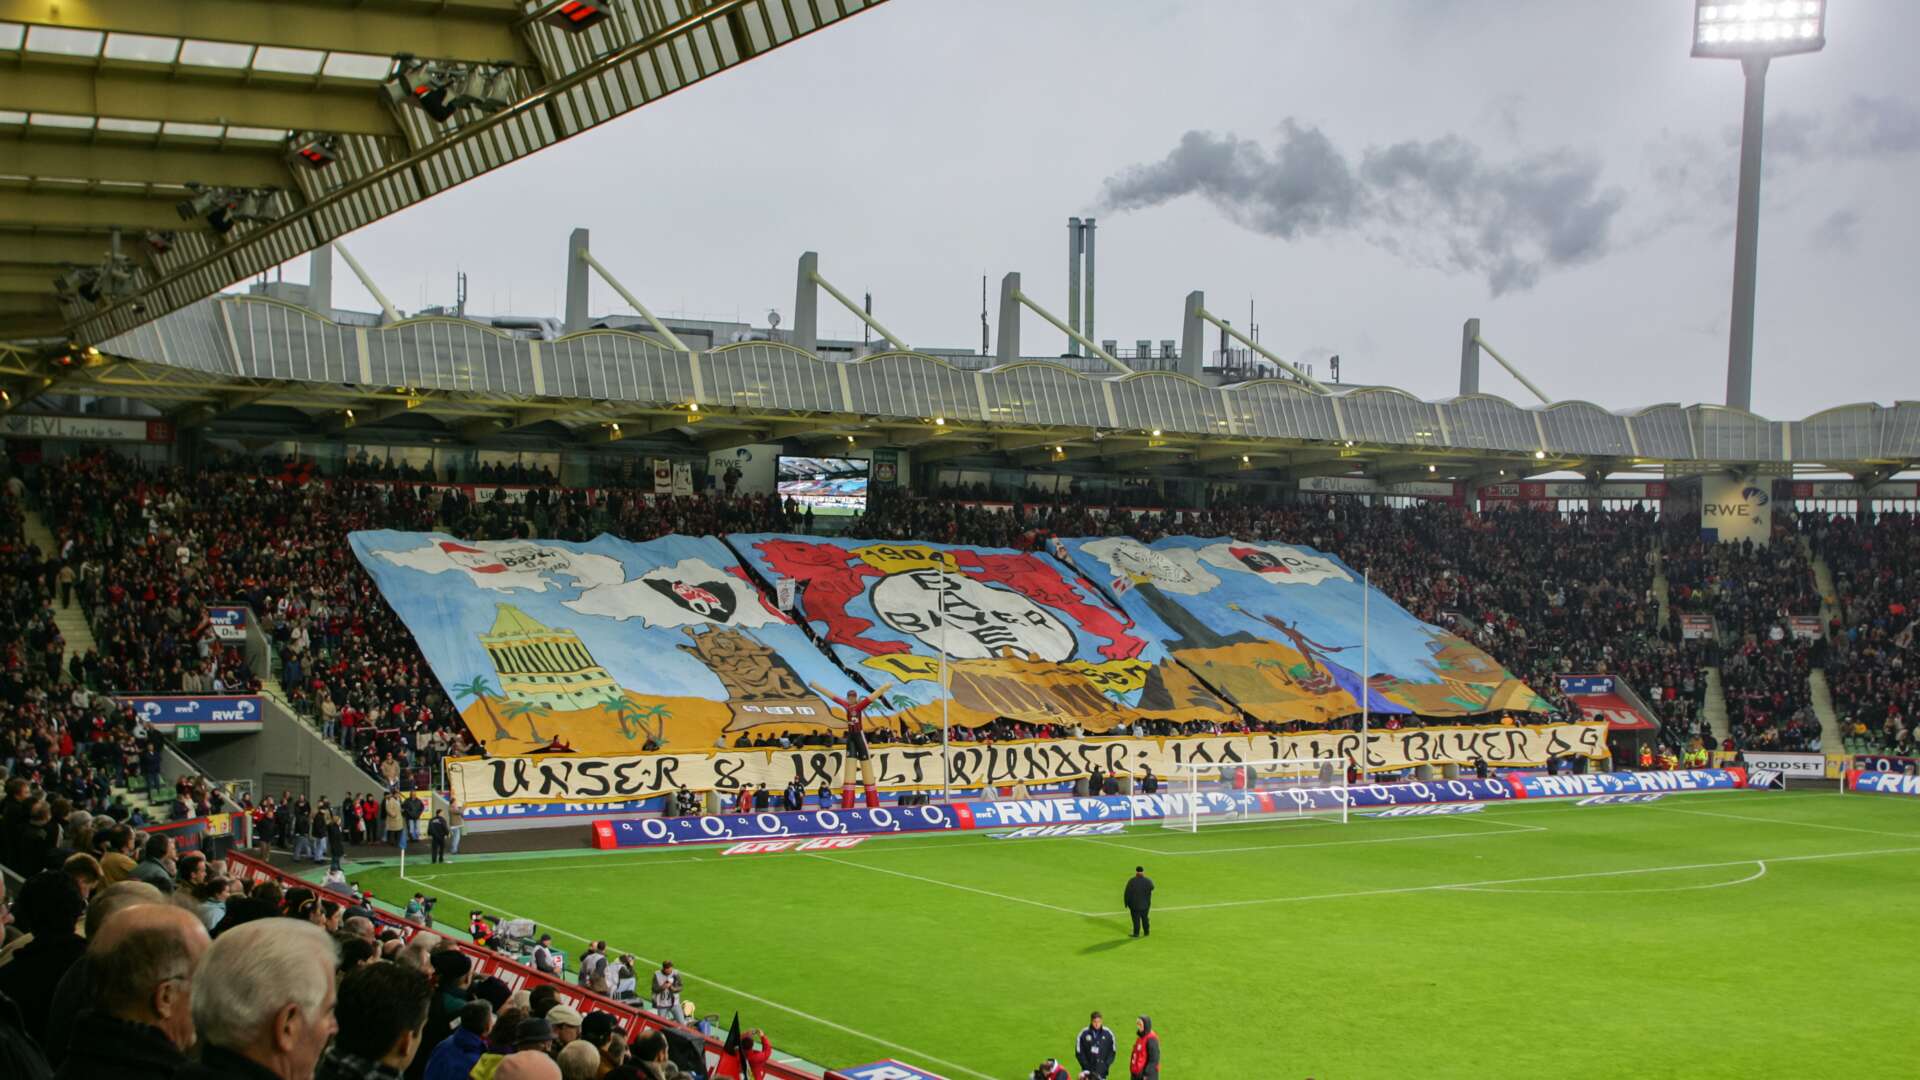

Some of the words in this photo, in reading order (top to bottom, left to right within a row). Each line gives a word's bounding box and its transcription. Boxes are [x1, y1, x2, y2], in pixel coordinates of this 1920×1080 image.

[1704, 504, 1749, 516] RWE
[212, 710, 245, 720] RWE
[489, 755, 682, 798] UNSER
[791, 743, 1152, 787] WLTWUNDER:
[1401, 730, 1533, 762] BAYER
[1755, 761, 1822, 771] ODDSET
[1448, 780, 1474, 800] O2
[1485, 778, 1510, 798] O2
[1535, 774, 1604, 795] RWE
[1632, 770, 1697, 791] RWE
[994, 799, 1082, 824] RWE
[1127, 793, 1210, 817] RWE
[642, 819, 678, 843] O2
[700, 816, 733, 840] O2
[757, 813, 788, 837] O2
[816, 810, 848, 834] O2
[869, 808, 901, 831] O2
[921, 805, 951, 828] O2
